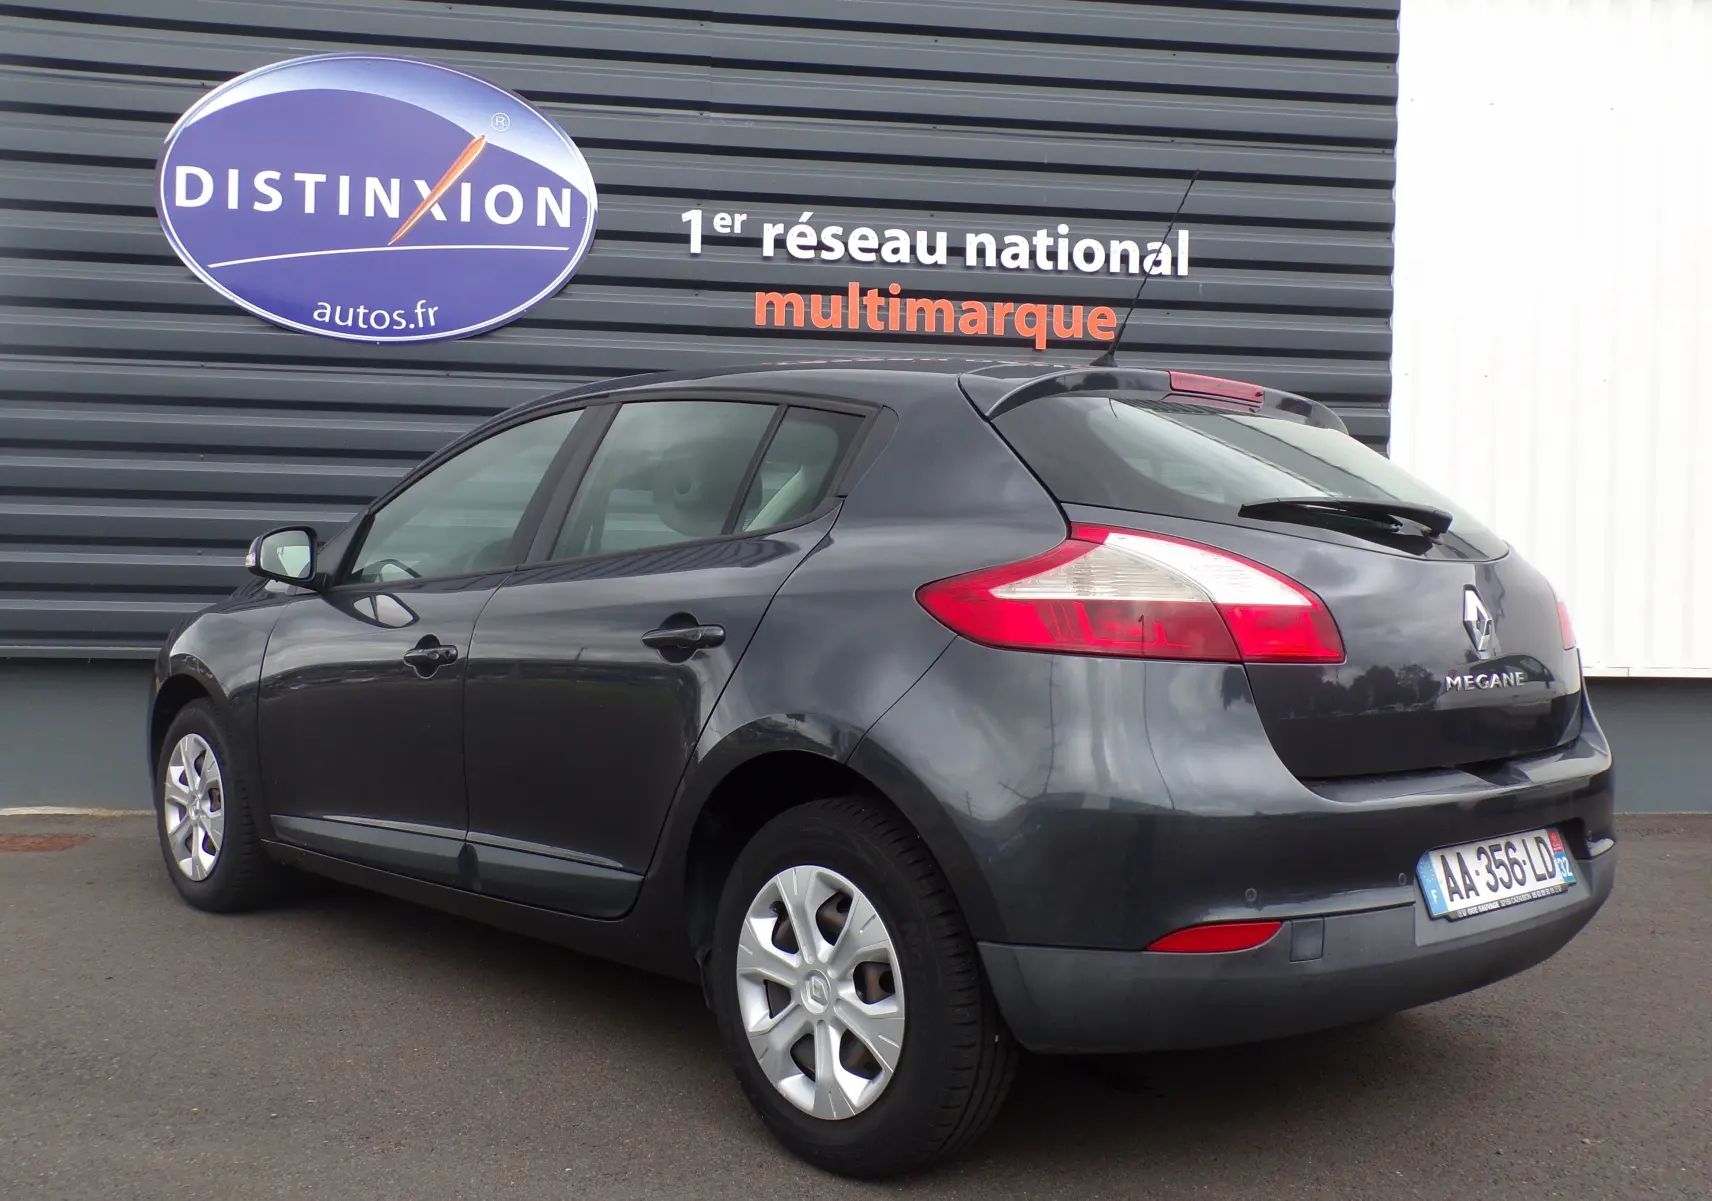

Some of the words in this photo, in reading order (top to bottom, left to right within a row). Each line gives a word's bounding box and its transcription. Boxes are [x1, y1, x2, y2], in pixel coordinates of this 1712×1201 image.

[174, 136, 572, 244] DISTINXION
[681, 208, 748, 254] 1er
[761, 211, 948, 266] réseau
[965, 223, 1190, 276] national
[312, 299, 440, 330] autos.fr
[754, 281, 1118, 350] multimarque
[1445, 671, 1526, 691] MEGANE
[1431, 889, 1438, 904] F
